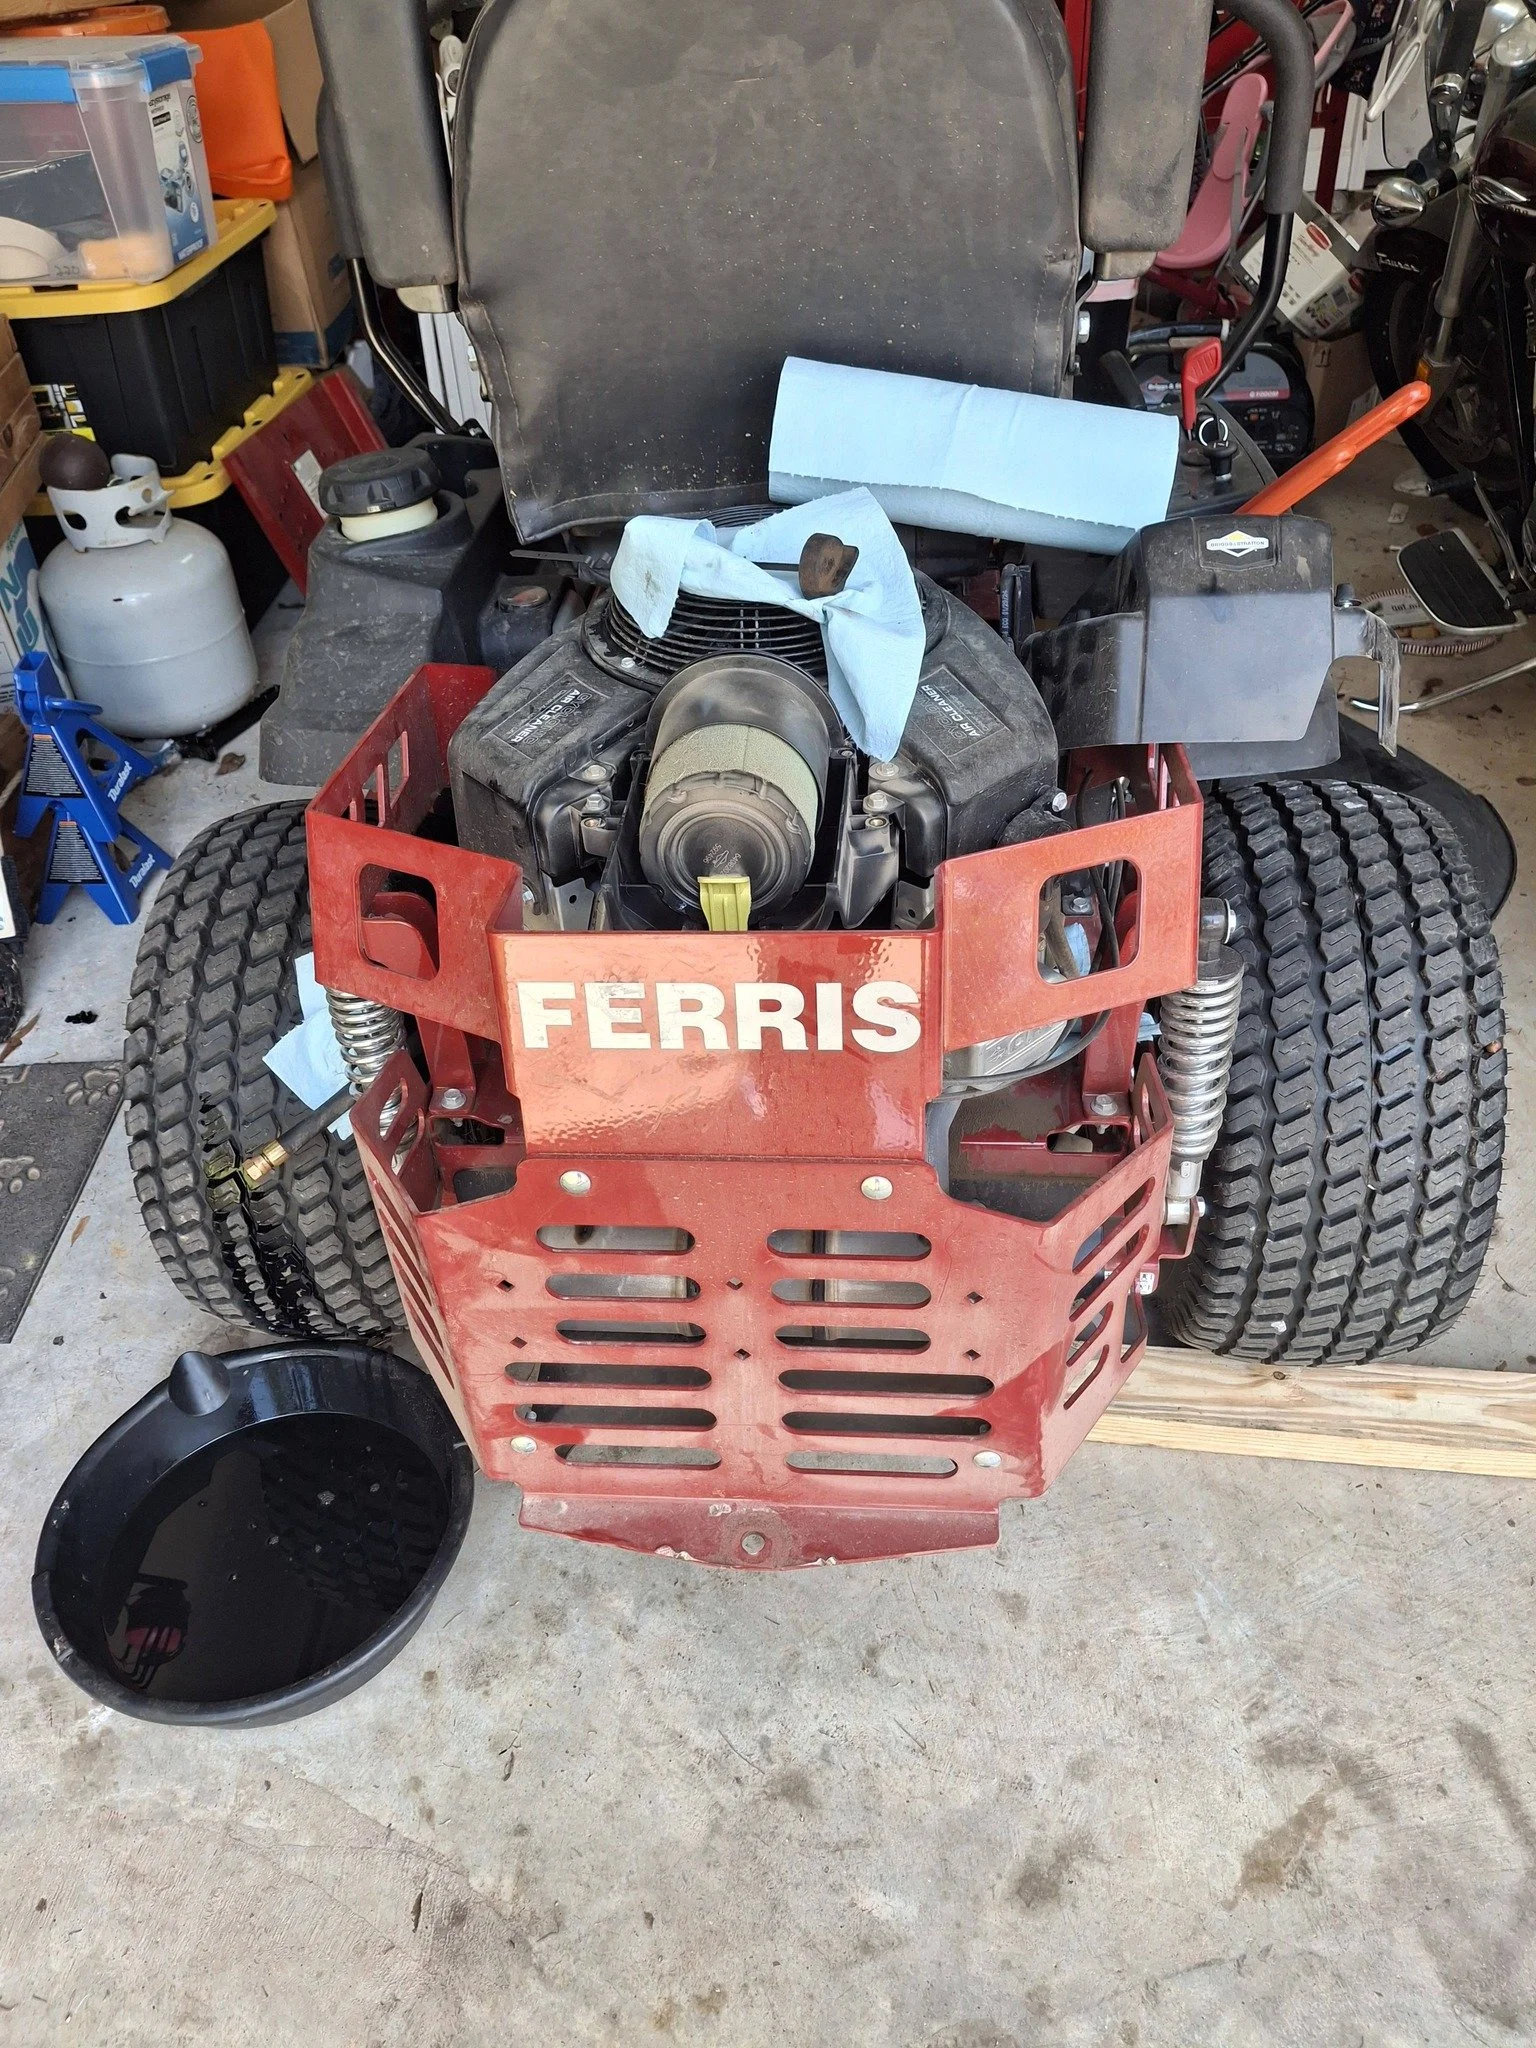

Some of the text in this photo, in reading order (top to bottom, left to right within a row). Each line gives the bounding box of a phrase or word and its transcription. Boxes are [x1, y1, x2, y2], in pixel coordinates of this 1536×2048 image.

[561, 689, 580, 703] AIR
[921, 684, 964, 722] CLEANER
[511, 704, 563, 743] CLEANER
[960, 722, 980, 737] AIR
[107, 760, 133, 802] Duralast
[128, 853, 156, 888] Duralast
[517, 981, 922, 1053] FERRIS
